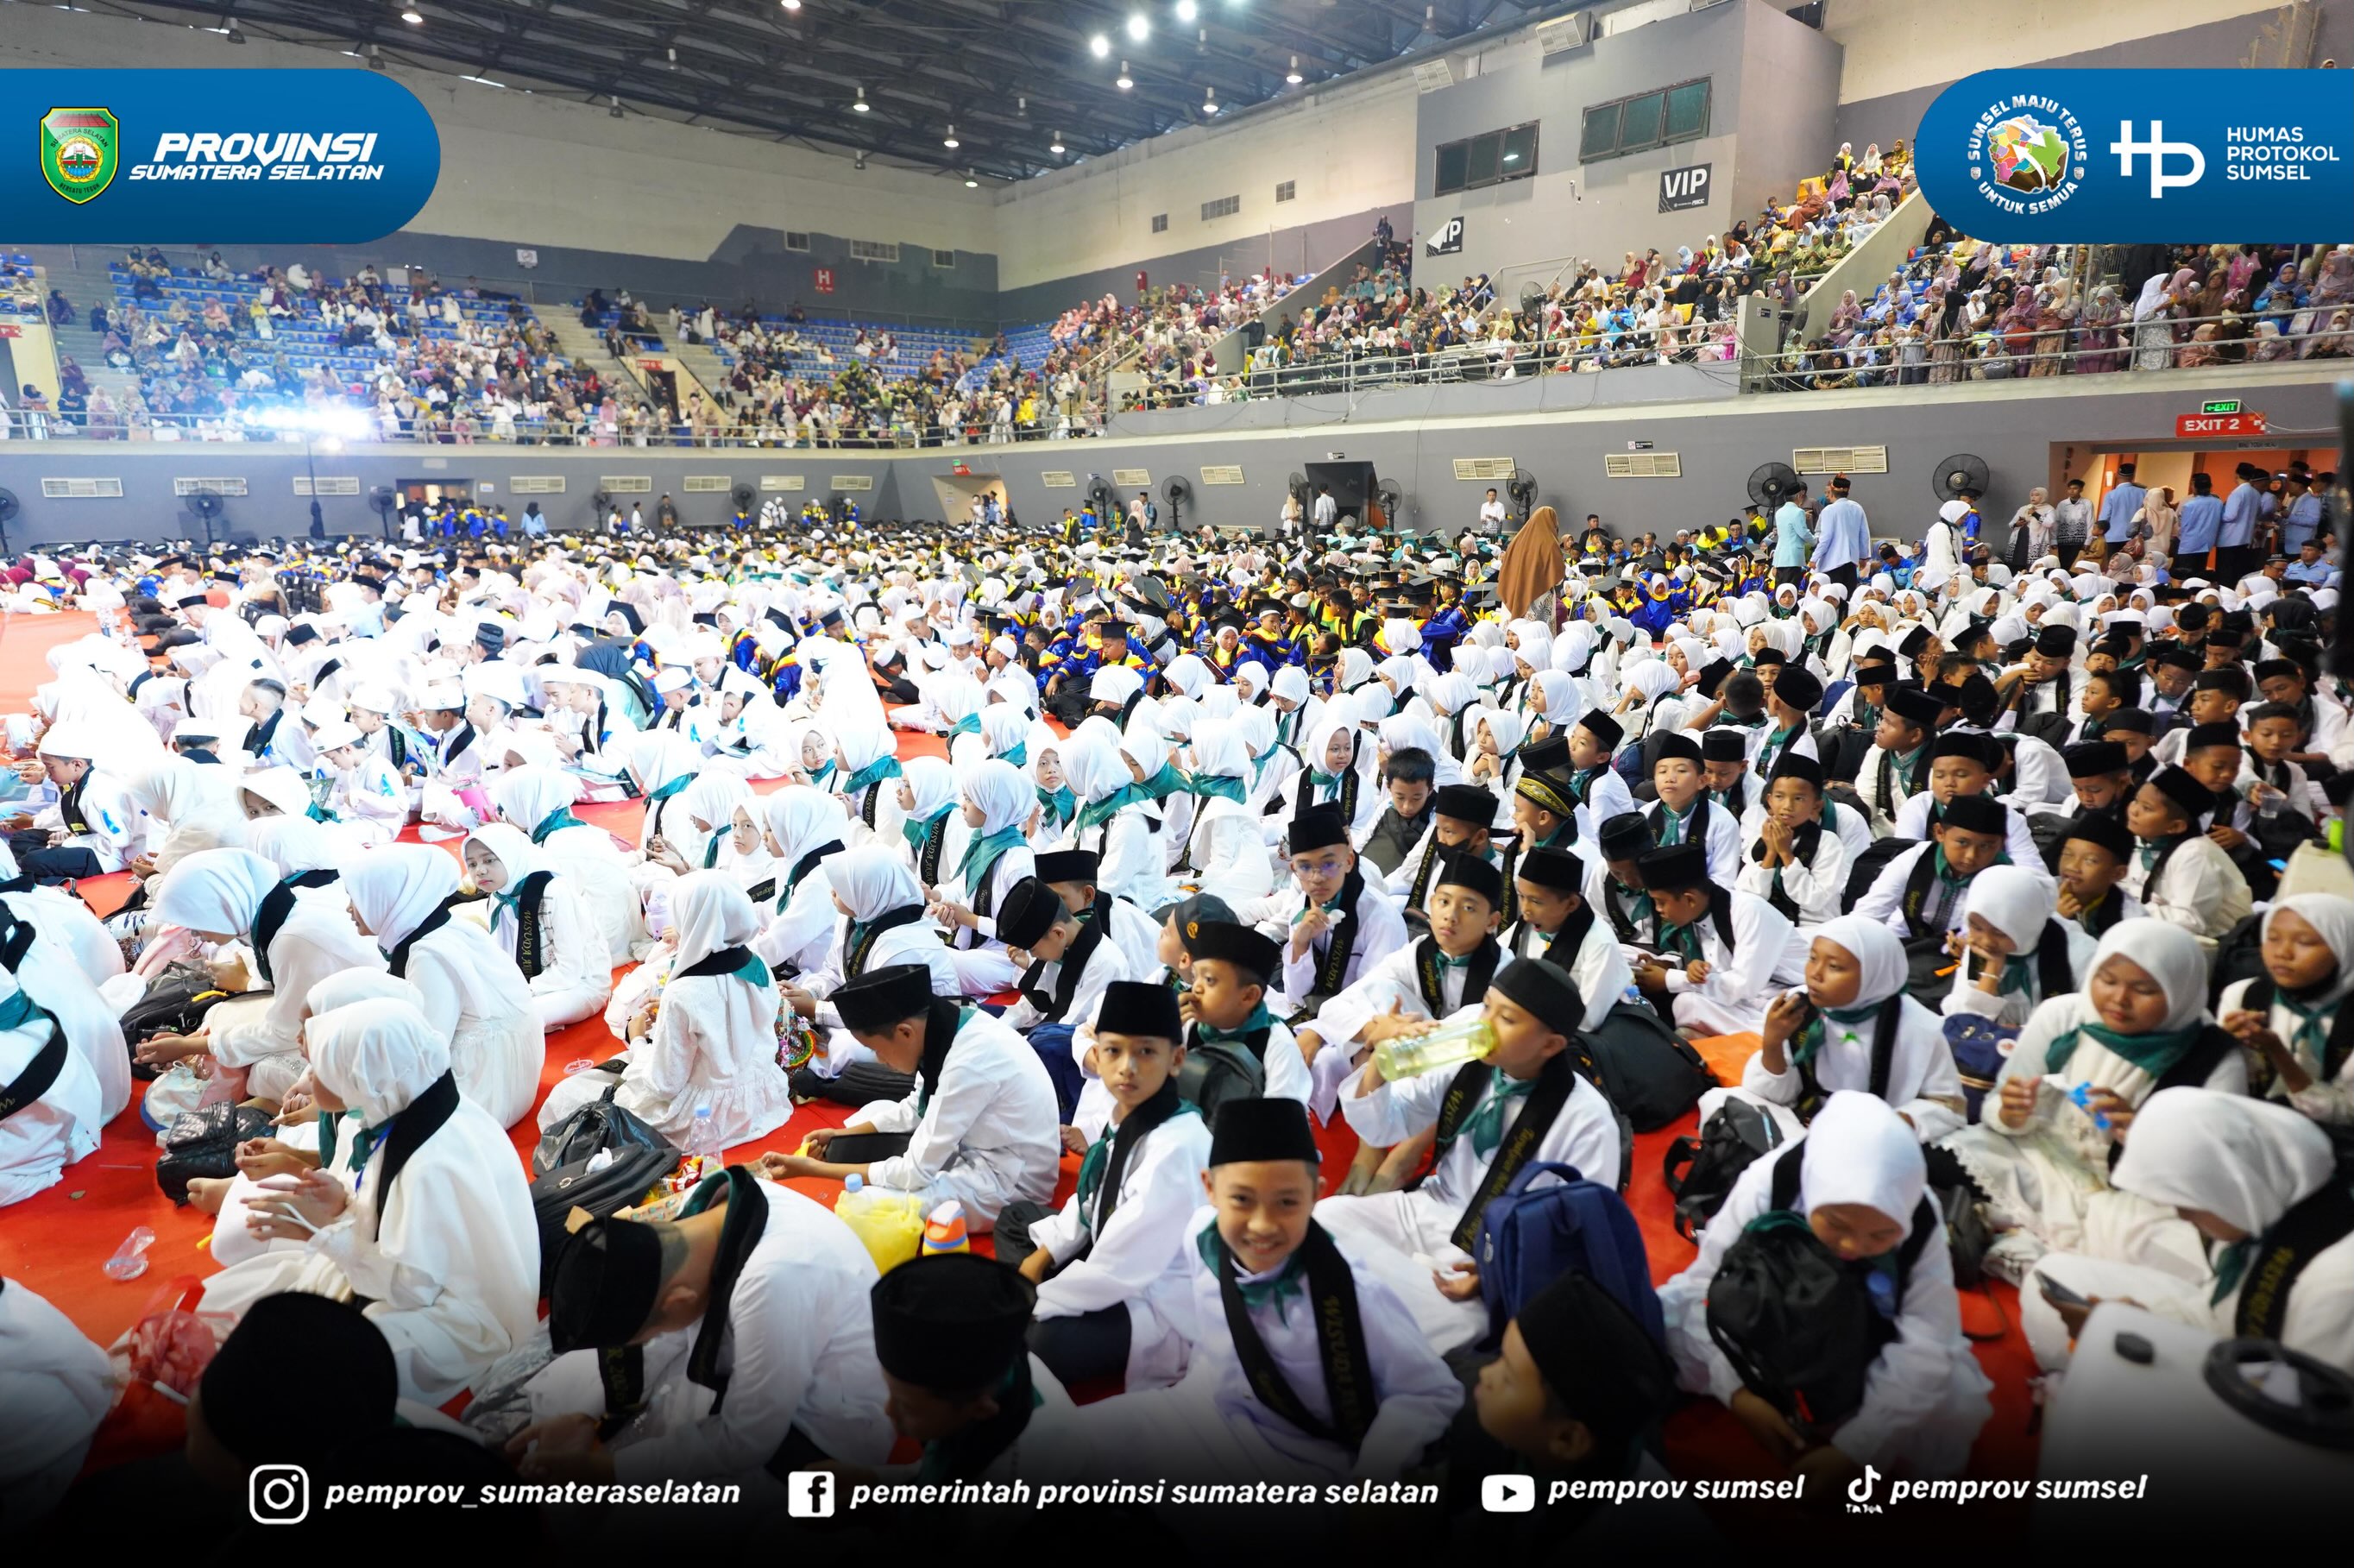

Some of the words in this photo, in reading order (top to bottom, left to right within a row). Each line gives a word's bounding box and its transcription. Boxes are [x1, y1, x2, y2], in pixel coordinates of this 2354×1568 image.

[1665, 168, 1708, 198] VIP
[818, 269, 830, 285] H
[2213, 402, 2237, 412] EXIT
[2184, 419, 2225, 431] EXIT
[2229, 419, 2240, 430] 2
[521, 910, 534, 955] WISUDA
[1325, 939, 1344, 990] WISUDA
